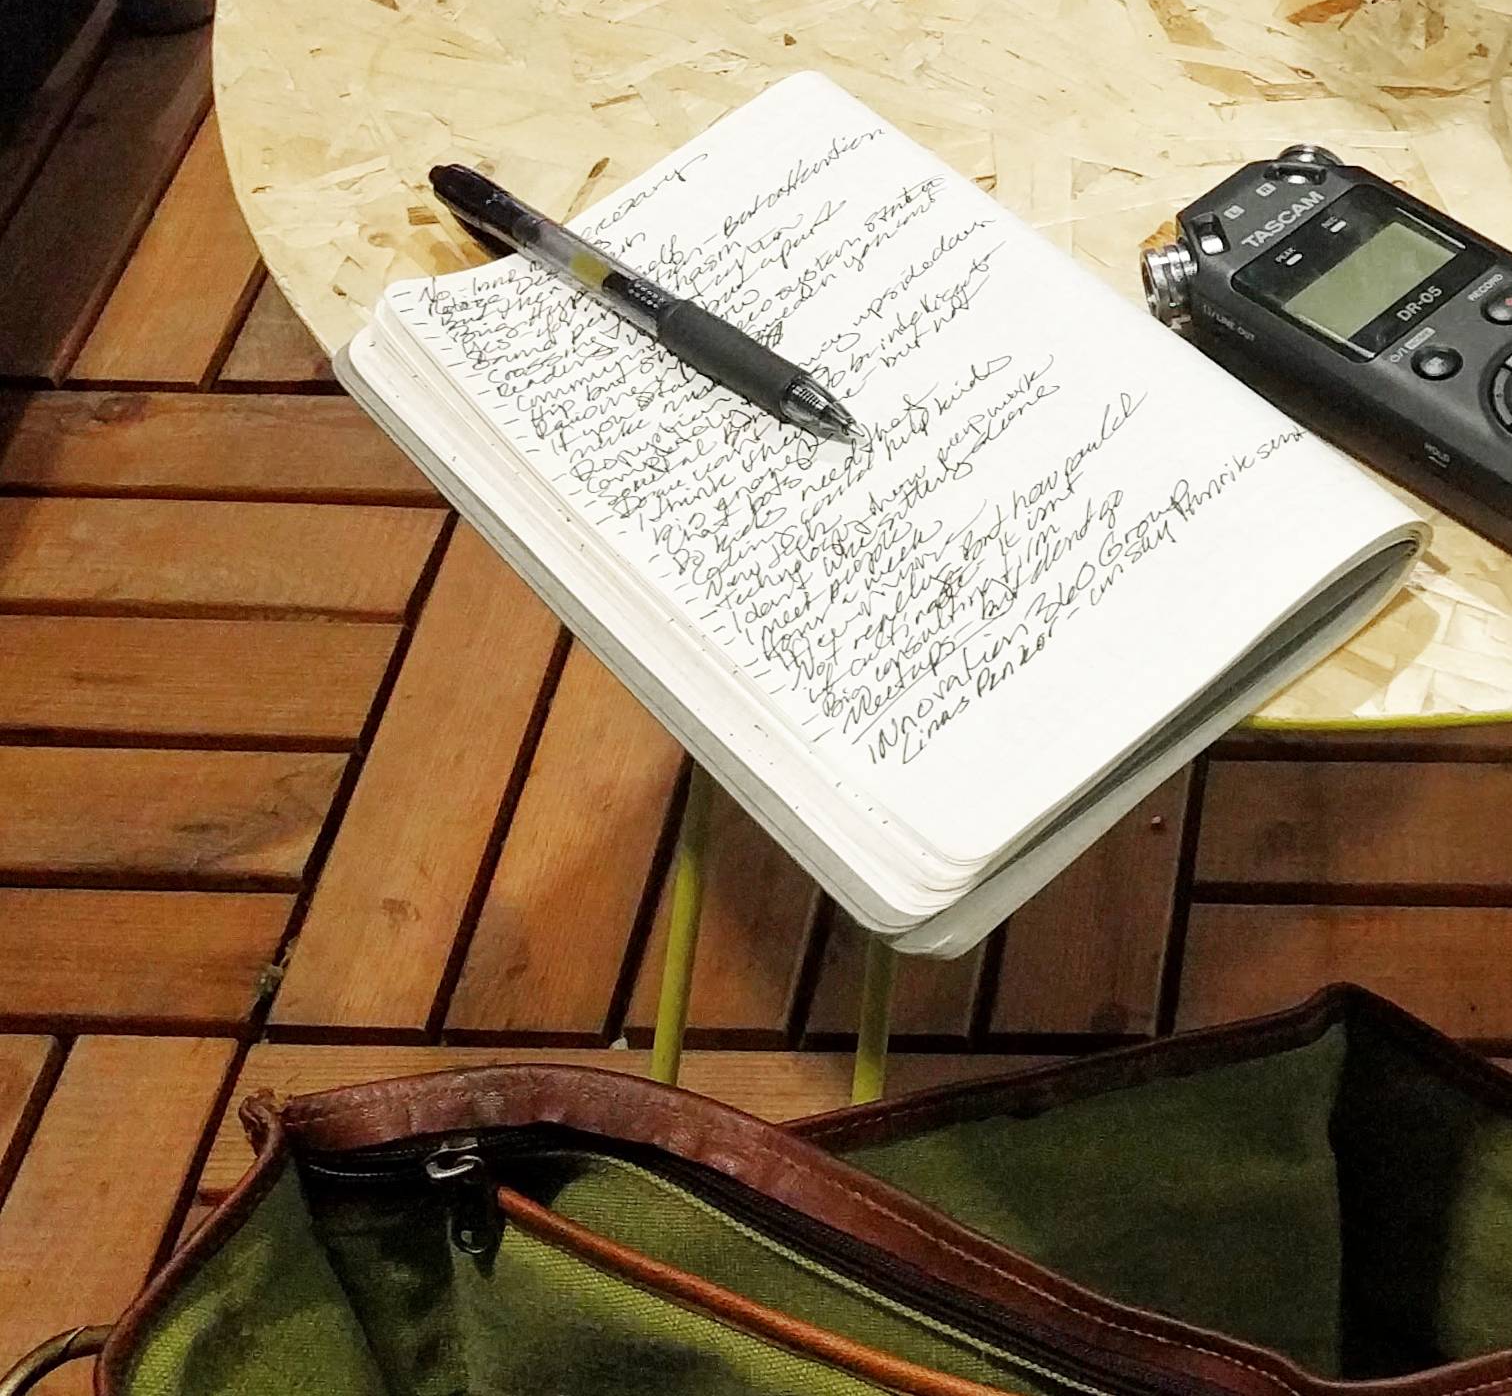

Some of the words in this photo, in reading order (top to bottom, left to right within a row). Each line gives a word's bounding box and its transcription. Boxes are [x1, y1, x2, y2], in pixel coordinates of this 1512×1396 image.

[1241, 190, 1325, 247] TASCAM
[1396, 285, 1442, 321] DR-05
[1467, 273, 1503, 301] RECORD
